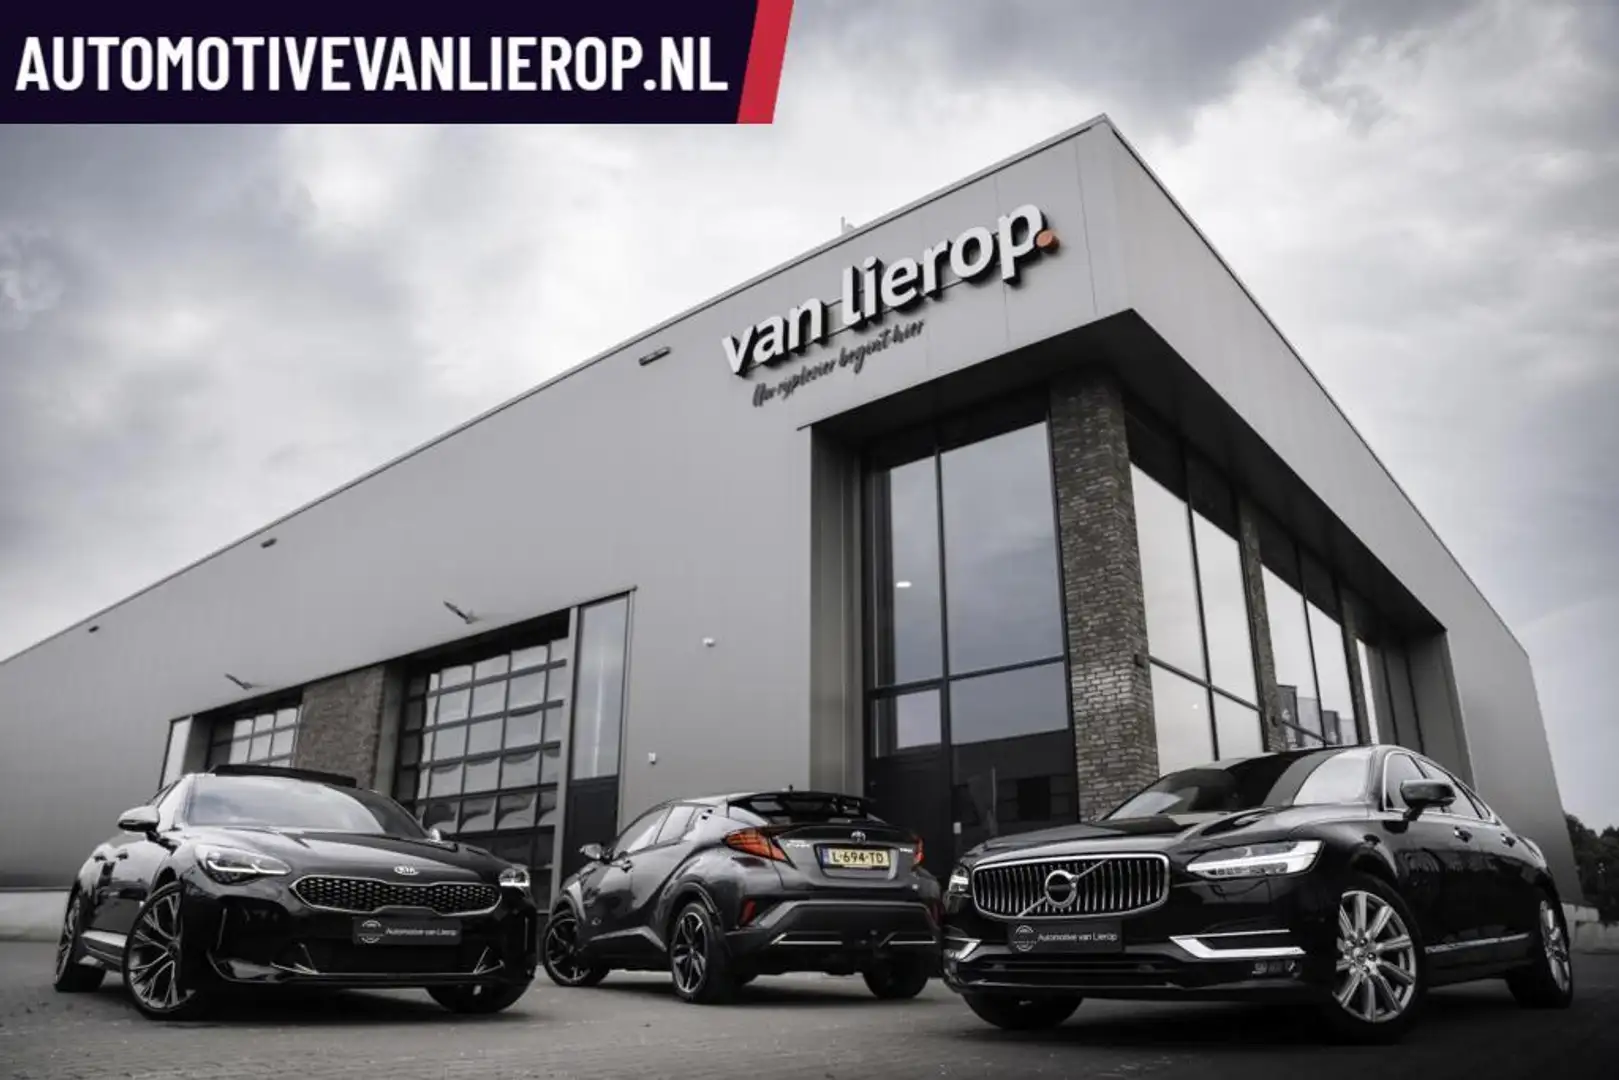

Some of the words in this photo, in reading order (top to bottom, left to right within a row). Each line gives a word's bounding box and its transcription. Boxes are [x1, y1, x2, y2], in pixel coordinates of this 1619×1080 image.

[722, 298, 823, 375] van
[1038, 933, 1077, 942] Automotive
[1078, 933, 1092, 942] van
